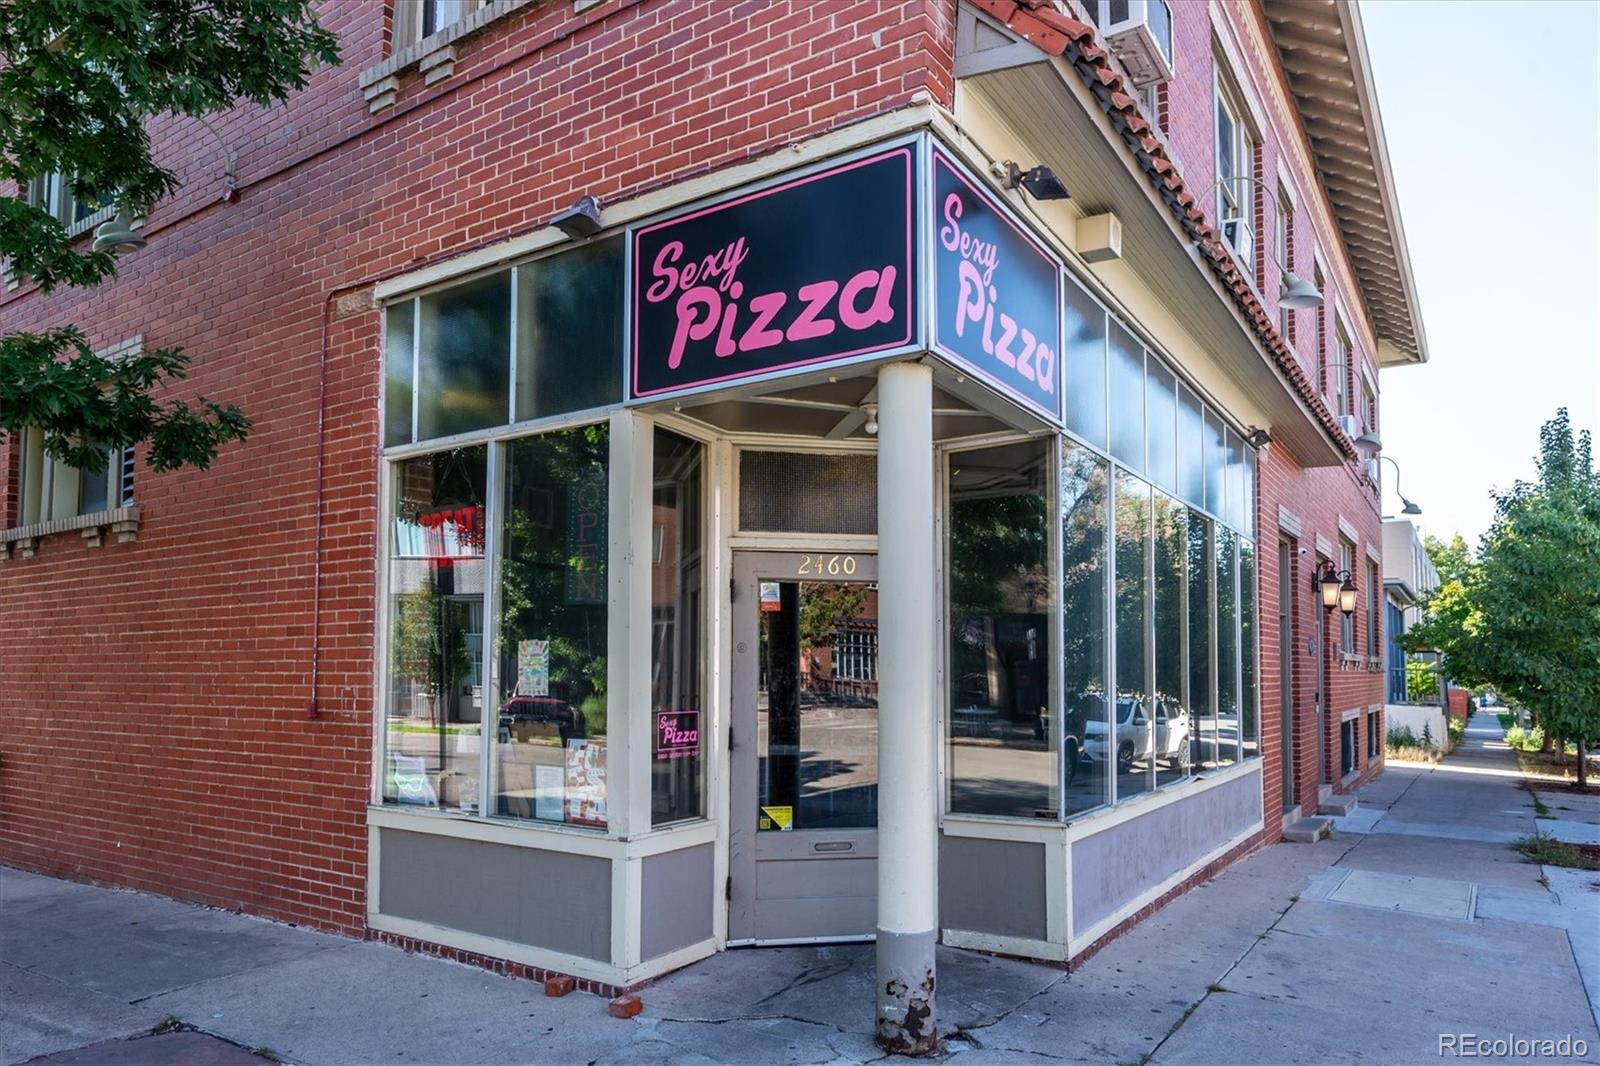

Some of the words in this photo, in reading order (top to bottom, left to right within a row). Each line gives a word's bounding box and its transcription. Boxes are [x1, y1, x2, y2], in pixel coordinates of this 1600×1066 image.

[646, 236, 749, 303] Sexy
[940, 192, 999, 287] Sexy
[668, 265, 897, 369] Pizza
[956, 260, 1055, 394] Pizza
[798, 555, 856, 575] 2460
[663, 727, 698, 744] Pizza
